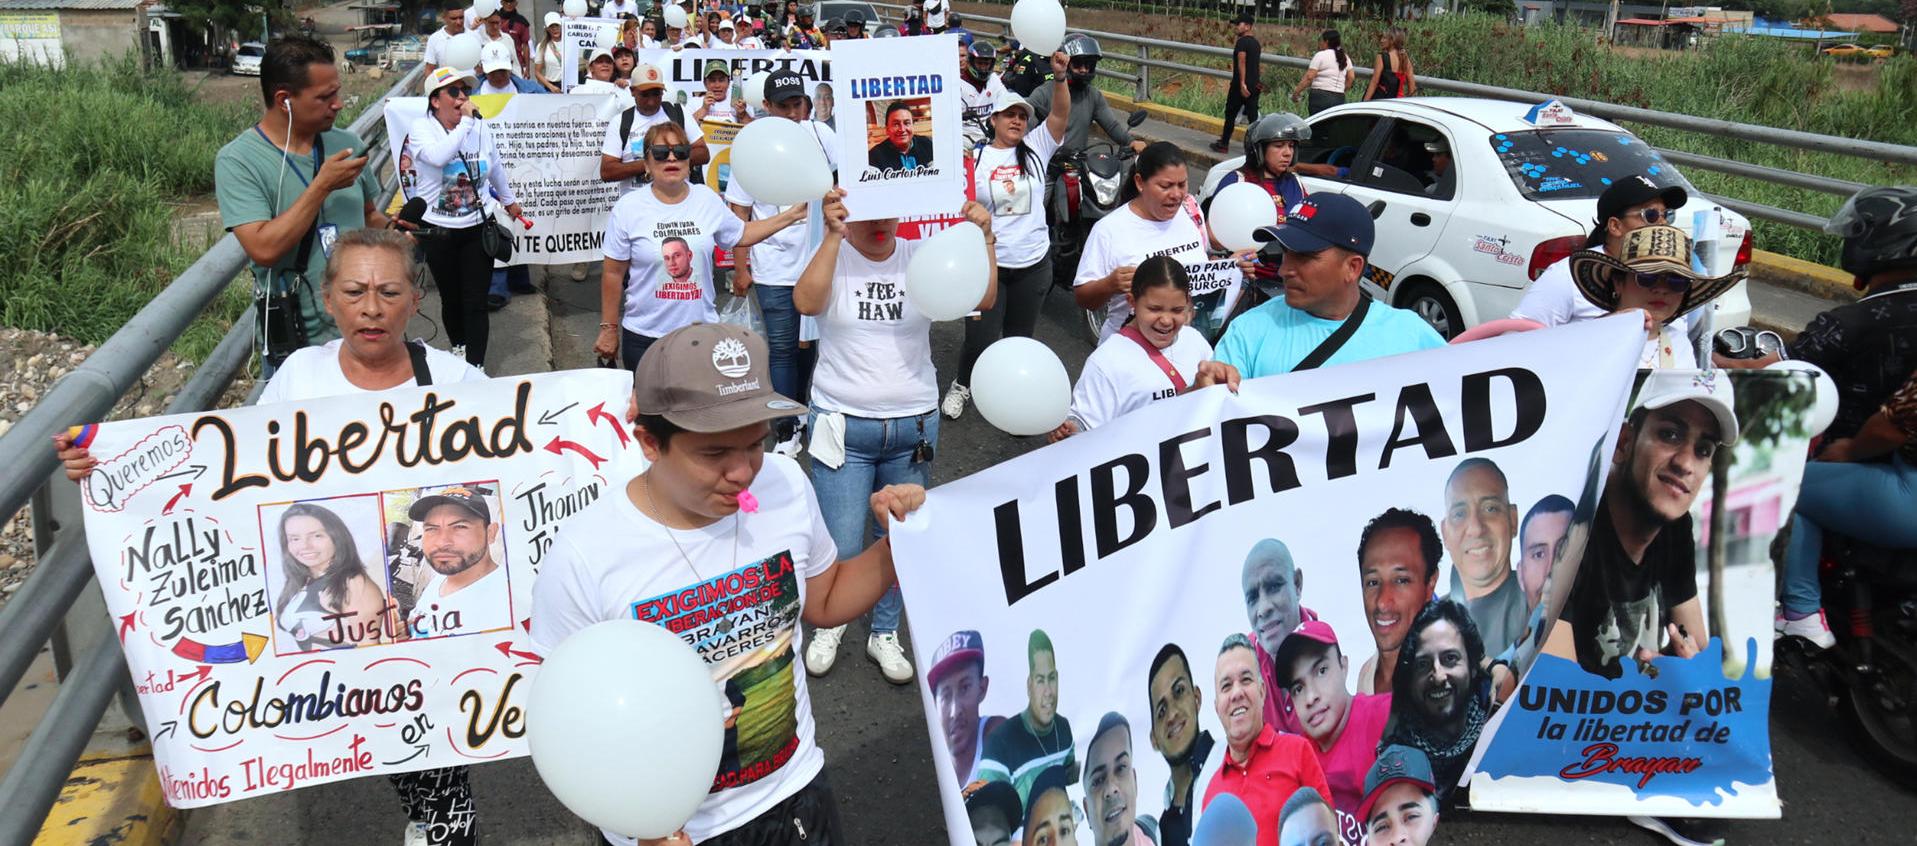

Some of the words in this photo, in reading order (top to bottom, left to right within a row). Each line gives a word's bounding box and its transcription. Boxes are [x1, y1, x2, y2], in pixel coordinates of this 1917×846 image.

[672, 58, 832, 82] LIERTA
[774, 77, 800, 88] BOSS
[851, 74, 943, 99] LIBERTAD
[504, 121, 511, 129] tu
[513, 121, 535, 129] sonrisa
[546, 121, 570, 129] nuestra
[505, 131, 533, 139] nuestras
[534, 130, 566, 138] oraciones
[572, 130, 580, 138] te
[525, 141, 535, 149] tus
[561, 140, 569, 148] tu
[518, 151, 526, 159] te
[527, 151, 554, 159] amamos
[560, 150, 593, 158] deseamos
[528, 179, 542, 187] esta
[543, 178, 562, 187] lucha
[859, 170, 881, 182] Luis
[883, 168, 913, 180] Carlos
[515, 188, 524, 198] de
[526, 188, 533, 198] la
[534, 187, 554, 197] fuerza
[555, 187, 567, 199] que
[568, 188, 575, 196] se
[576, 186, 604, 195] encuentra
[538, 208, 545, 216] es
[546, 208, 554, 216] un
[555, 206, 571, 218] grito
[572, 206, 580, 215] de
[581, 206, 597, 214] amor
[540, 197, 559, 207] Cada
[559, 198, 574, 209] paso
[575, 198, 587, 209] que
[653, 227, 701, 238] COLMENARES
[657, 222, 678, 230] EDWIN
[679, 220, 695, 229] IVAN
[524, 235, 541, 253] TE
[545, 231, 606, 253] QUEREM
[1204, 261, 1236, 273] PARA
[865, 282, 896, 300] YEE
[1188, 277, 1232, 291] BURGOS
[858, 301, 903, 320] HAW
[715, 377, 760, 396] Timberland
[1152, 388, 1177, 400] LIB
[191, 380, 533, 501] Libertad
[88, 434, 185, 510] Queremos
[993, 366, 1548, 607] LIBERTAD
[149, 553, 257, 607] Zuleima
[635, 566, 759, 623] EXIGIMOS
[762, 554, 794, 581] LA
[761, 582, 783, 602] DE
[321, 597, 463, 645] Justicia
[188, 670, 423, 739] Colombianos
[1518, 685, 1668, 715] UNIDOS
[1678, 686, 1743, 716] POR
[401, 712, 435, 744] en
[1536, 716, 1567, 741] la
[1572, 718, 1690, 743] libertad
[1694, 721, 1731, 744] de
[239, 734, 374, 792] Ilegalmente
[1560, 742, 1703, 789] Brayan
